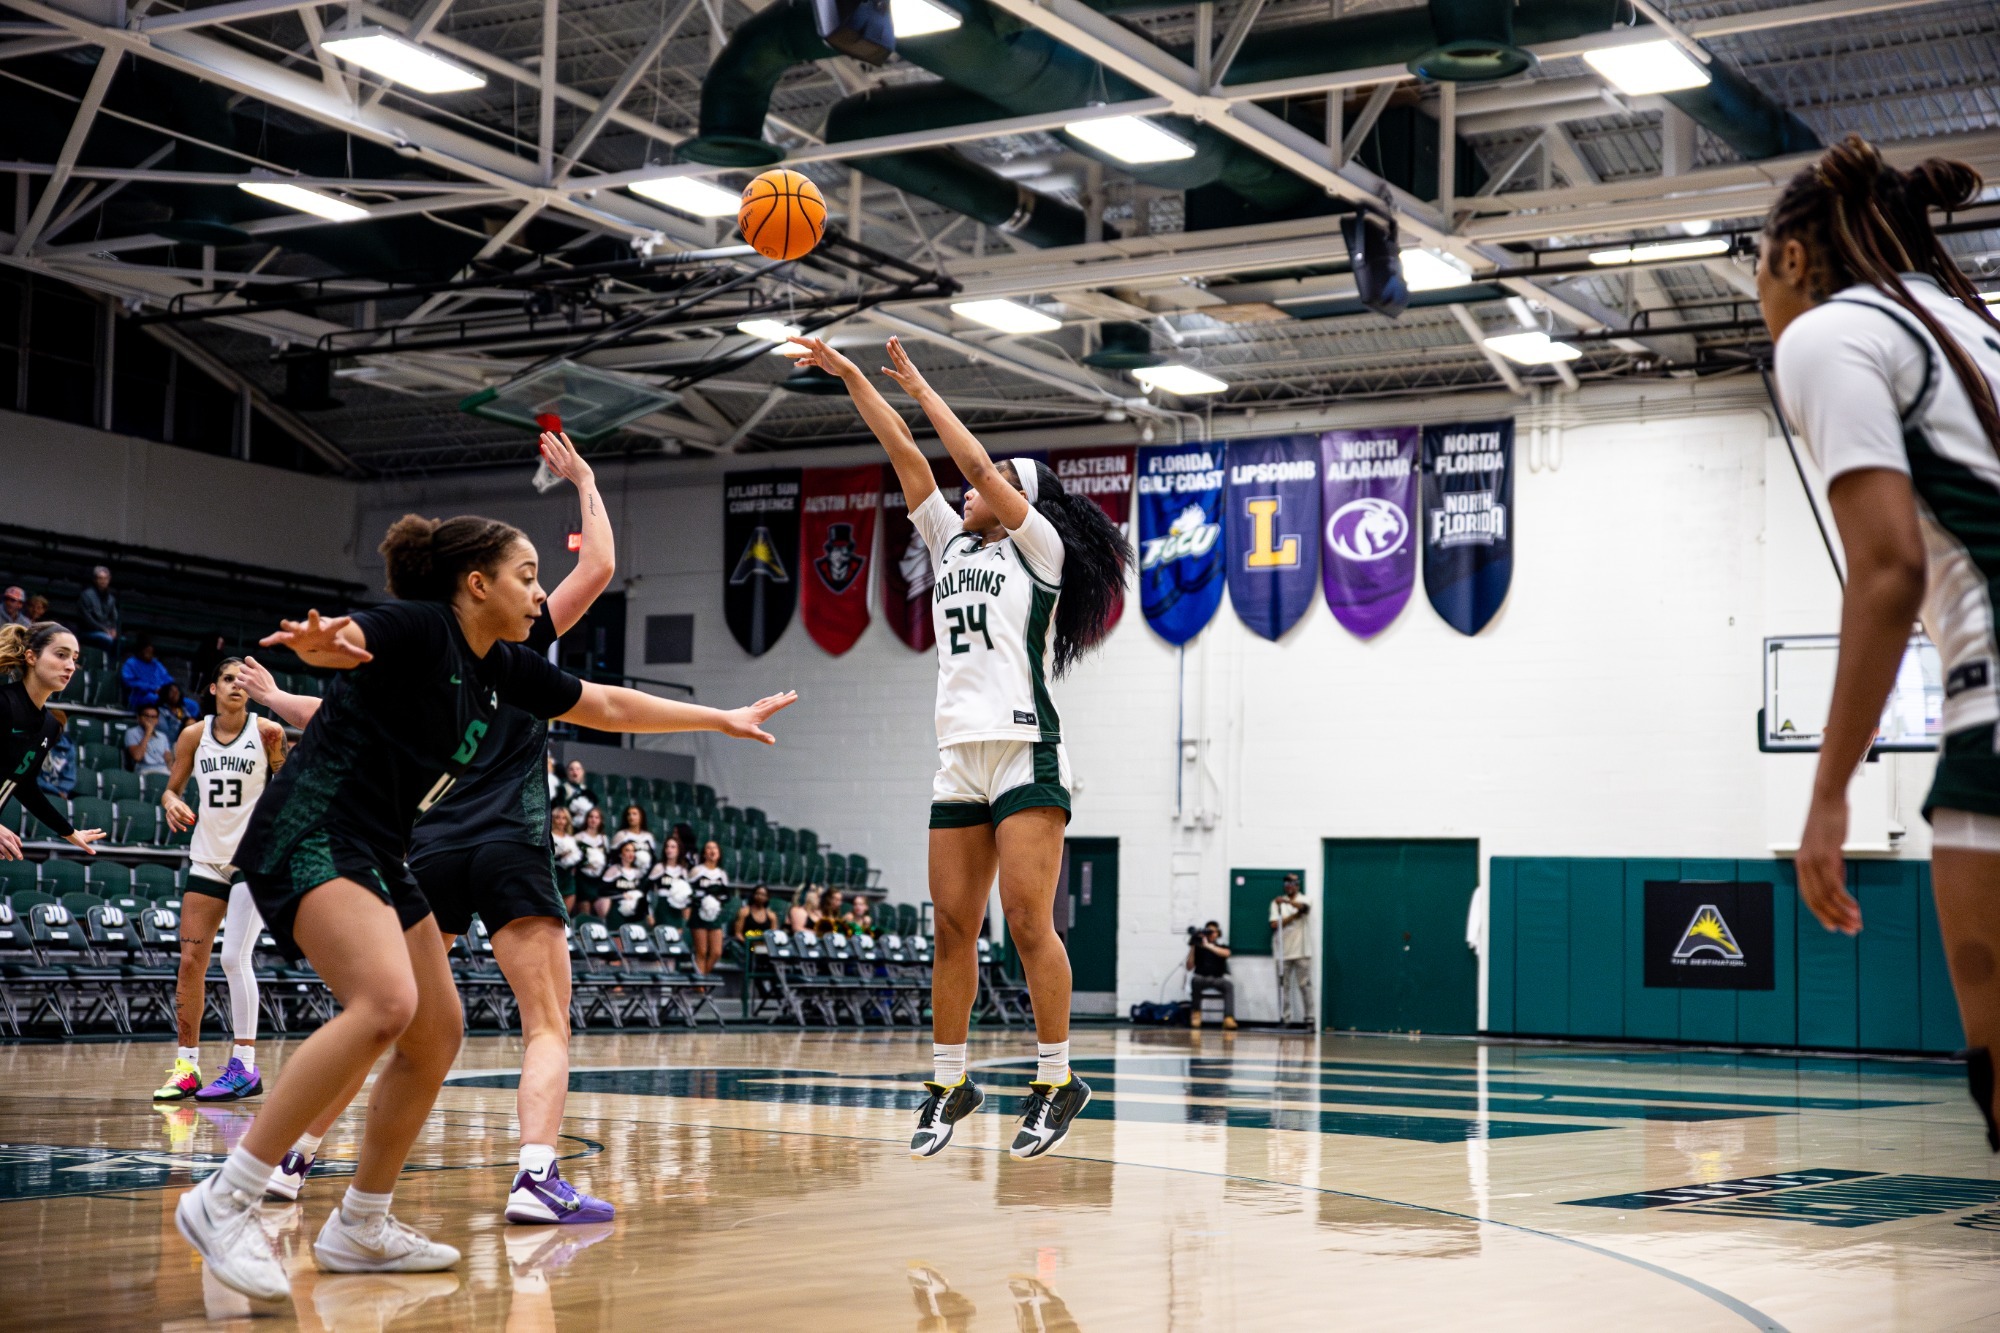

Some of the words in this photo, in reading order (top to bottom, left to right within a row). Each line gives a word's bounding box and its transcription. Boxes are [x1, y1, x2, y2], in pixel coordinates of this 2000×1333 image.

[1342, 439, 1398, 460] NORTH
[1445, 432, 1500, 454] NORTH
[1058, 455, 1127, 476] EASTERN
[1149, 452, 1214, 473] FLORIDA
[1231, 460, 1316, 485] LIPSCOMB
[1328, 458, 1410, 481] ALABAMA
[1436, 451, 1504, 474] FLORIDA
[727, 484, 773, 499] ATLANTIC
[776, 482, 799, 496] SUN
[1062, 474, 1132, 495] ENTUCKY
[1139, 475, 1175, 494] GULF
[1176, 470, 1225, 493] COAST
[729, 497, 795, 514] CONFERENCE
[804, 494, 846, 513] AUSTIN
[1445, 492, 1492, 513] NORTH
[1246, 495, 1301, 572] L
[1432, 506, 1504, 541] FLORIDA
[935, 568, 1006, 605] DOLPHINS
[944, 602, 995, 656] 24
[451, 719, 489, 765] S
[14, 751, 36, 775] S
[200, 756, 256, 776] DOLPHINS
[209, 778, 243, 808] 23
[44, 904, 68, 924] JU
[101, 906, 124, 926] JU
[153, 909, 176, 928] JU
